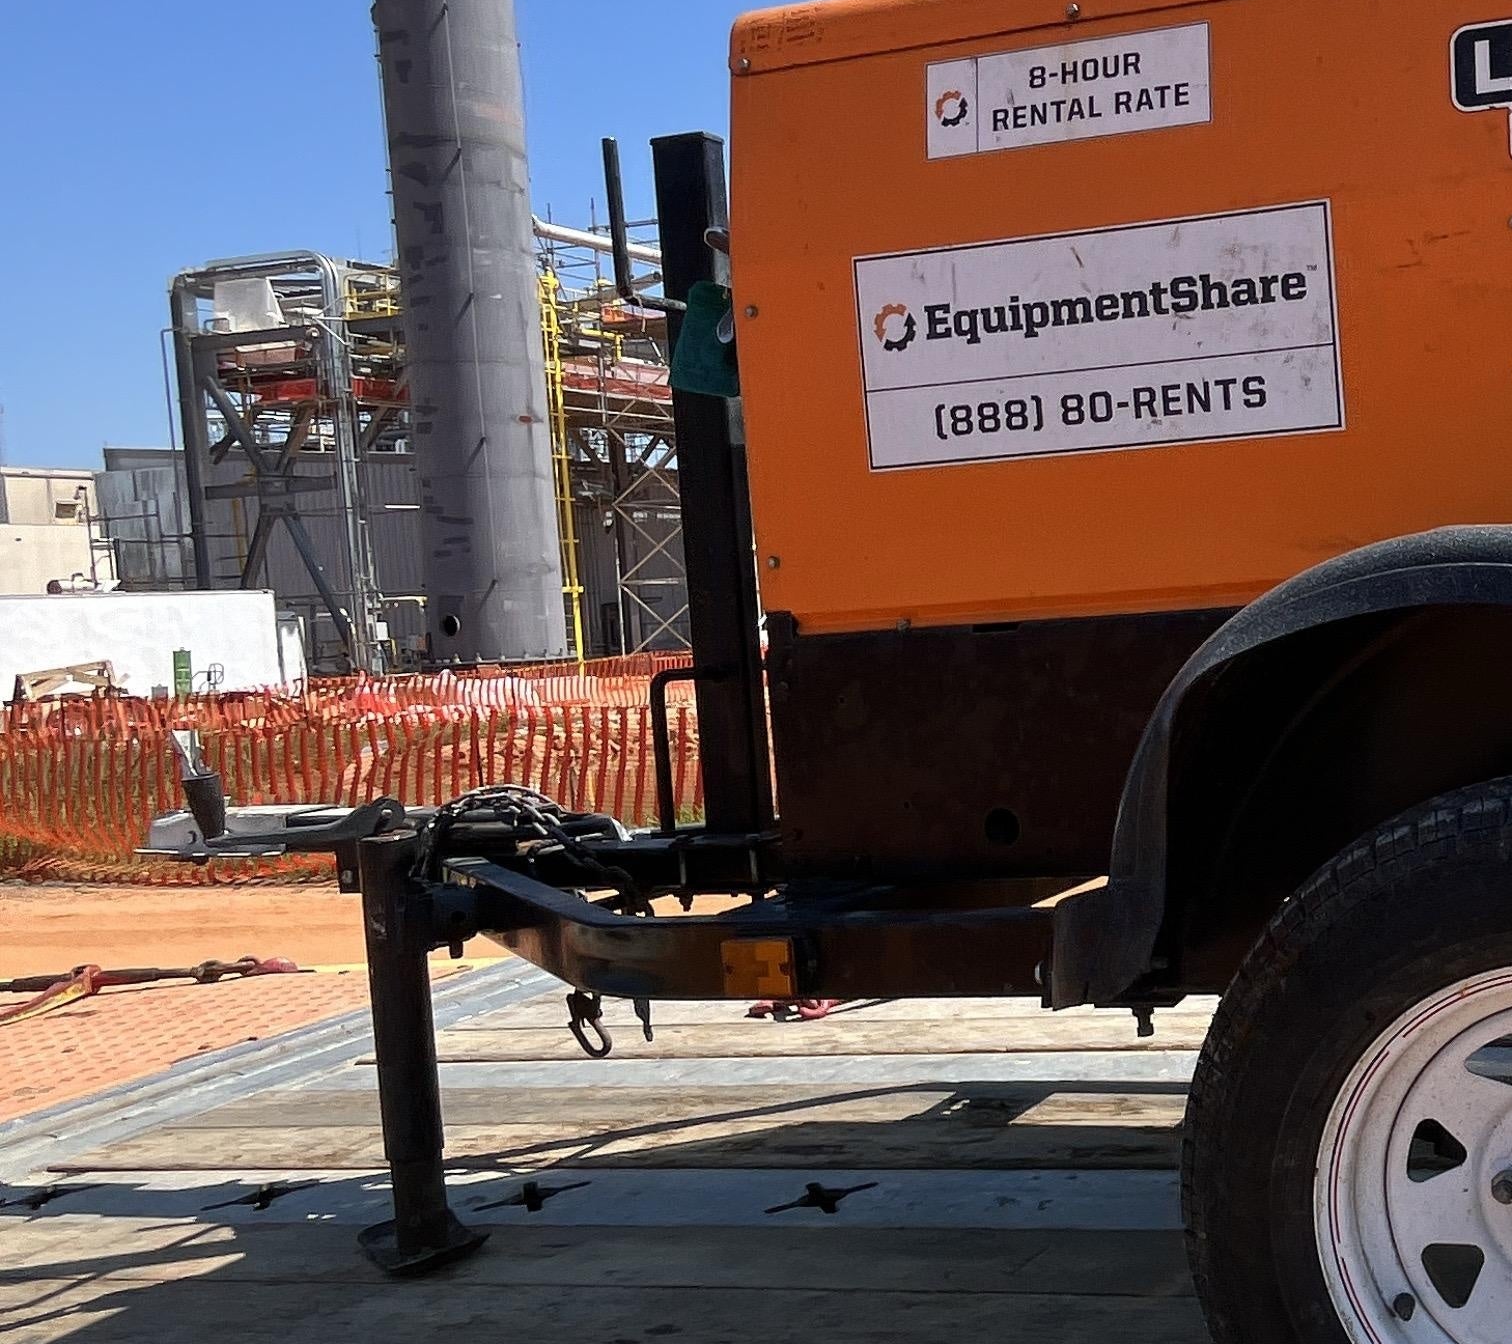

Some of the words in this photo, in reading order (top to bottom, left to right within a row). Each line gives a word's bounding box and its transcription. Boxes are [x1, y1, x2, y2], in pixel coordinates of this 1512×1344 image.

[1028, 52, 1141, 89] 8-HOUR
[992, 95, 1103, 132] RENTAL
[1114, 82, 1190, 115] RATE
[923, 272, 1308, 345] EquipmentShare
[934, 394, 1044, 440] (888)
[1060, 375, 1267, 426] 80-RENTS
